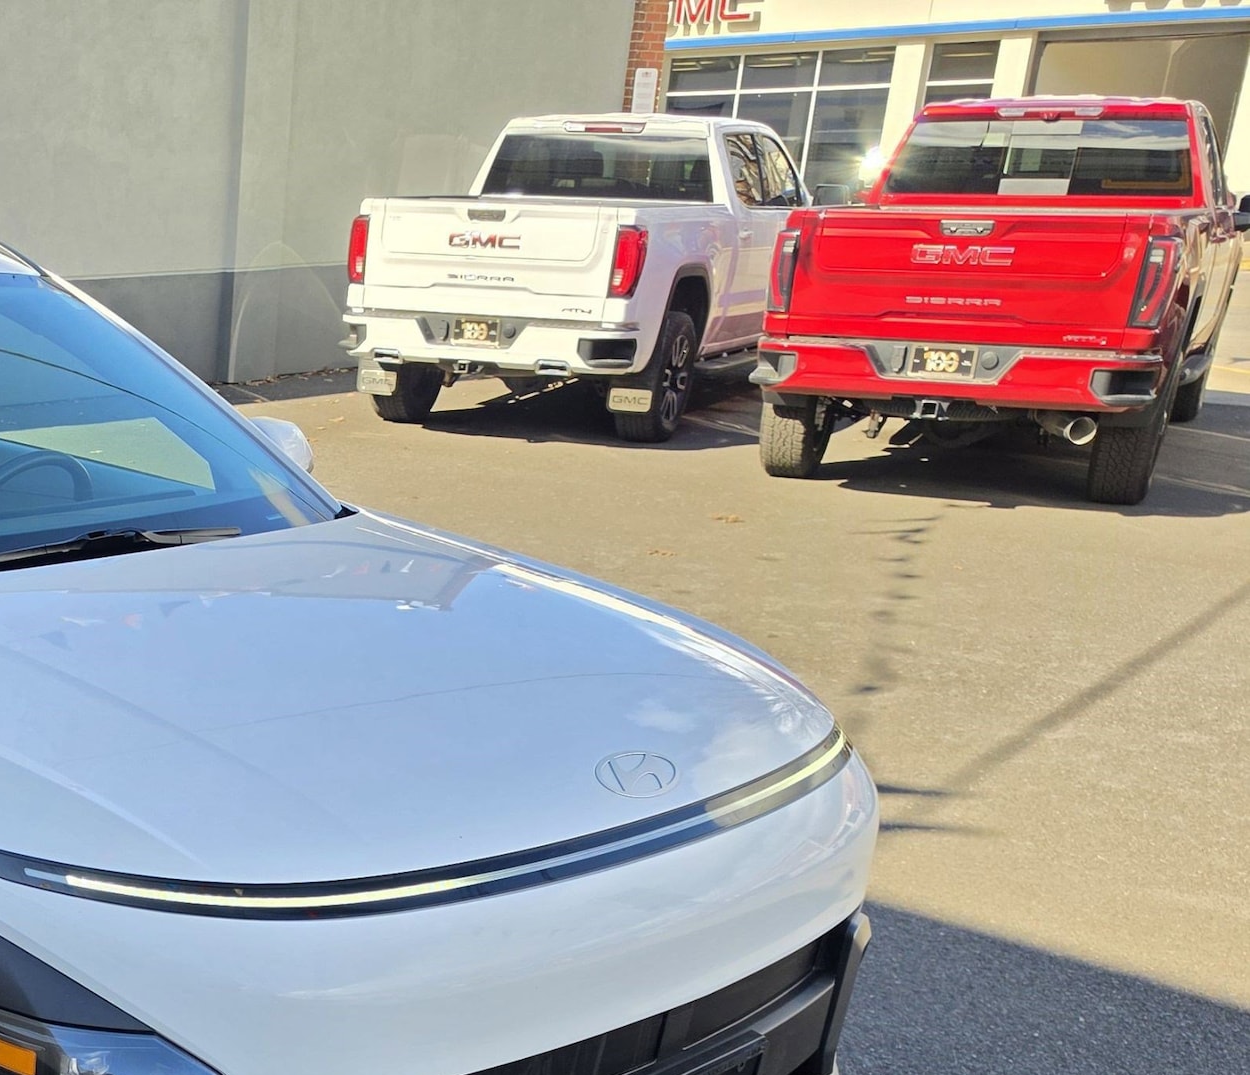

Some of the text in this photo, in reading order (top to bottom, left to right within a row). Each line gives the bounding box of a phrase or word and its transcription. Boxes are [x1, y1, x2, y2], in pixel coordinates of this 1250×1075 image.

[666, 0, 753, 26] MC
[448, 232, 521, 250] GMC
[910, 243, 1015, 266] GMC
[905, 295, 1002, 306] SIERRA
[612, 395, 650, 405] GMC
